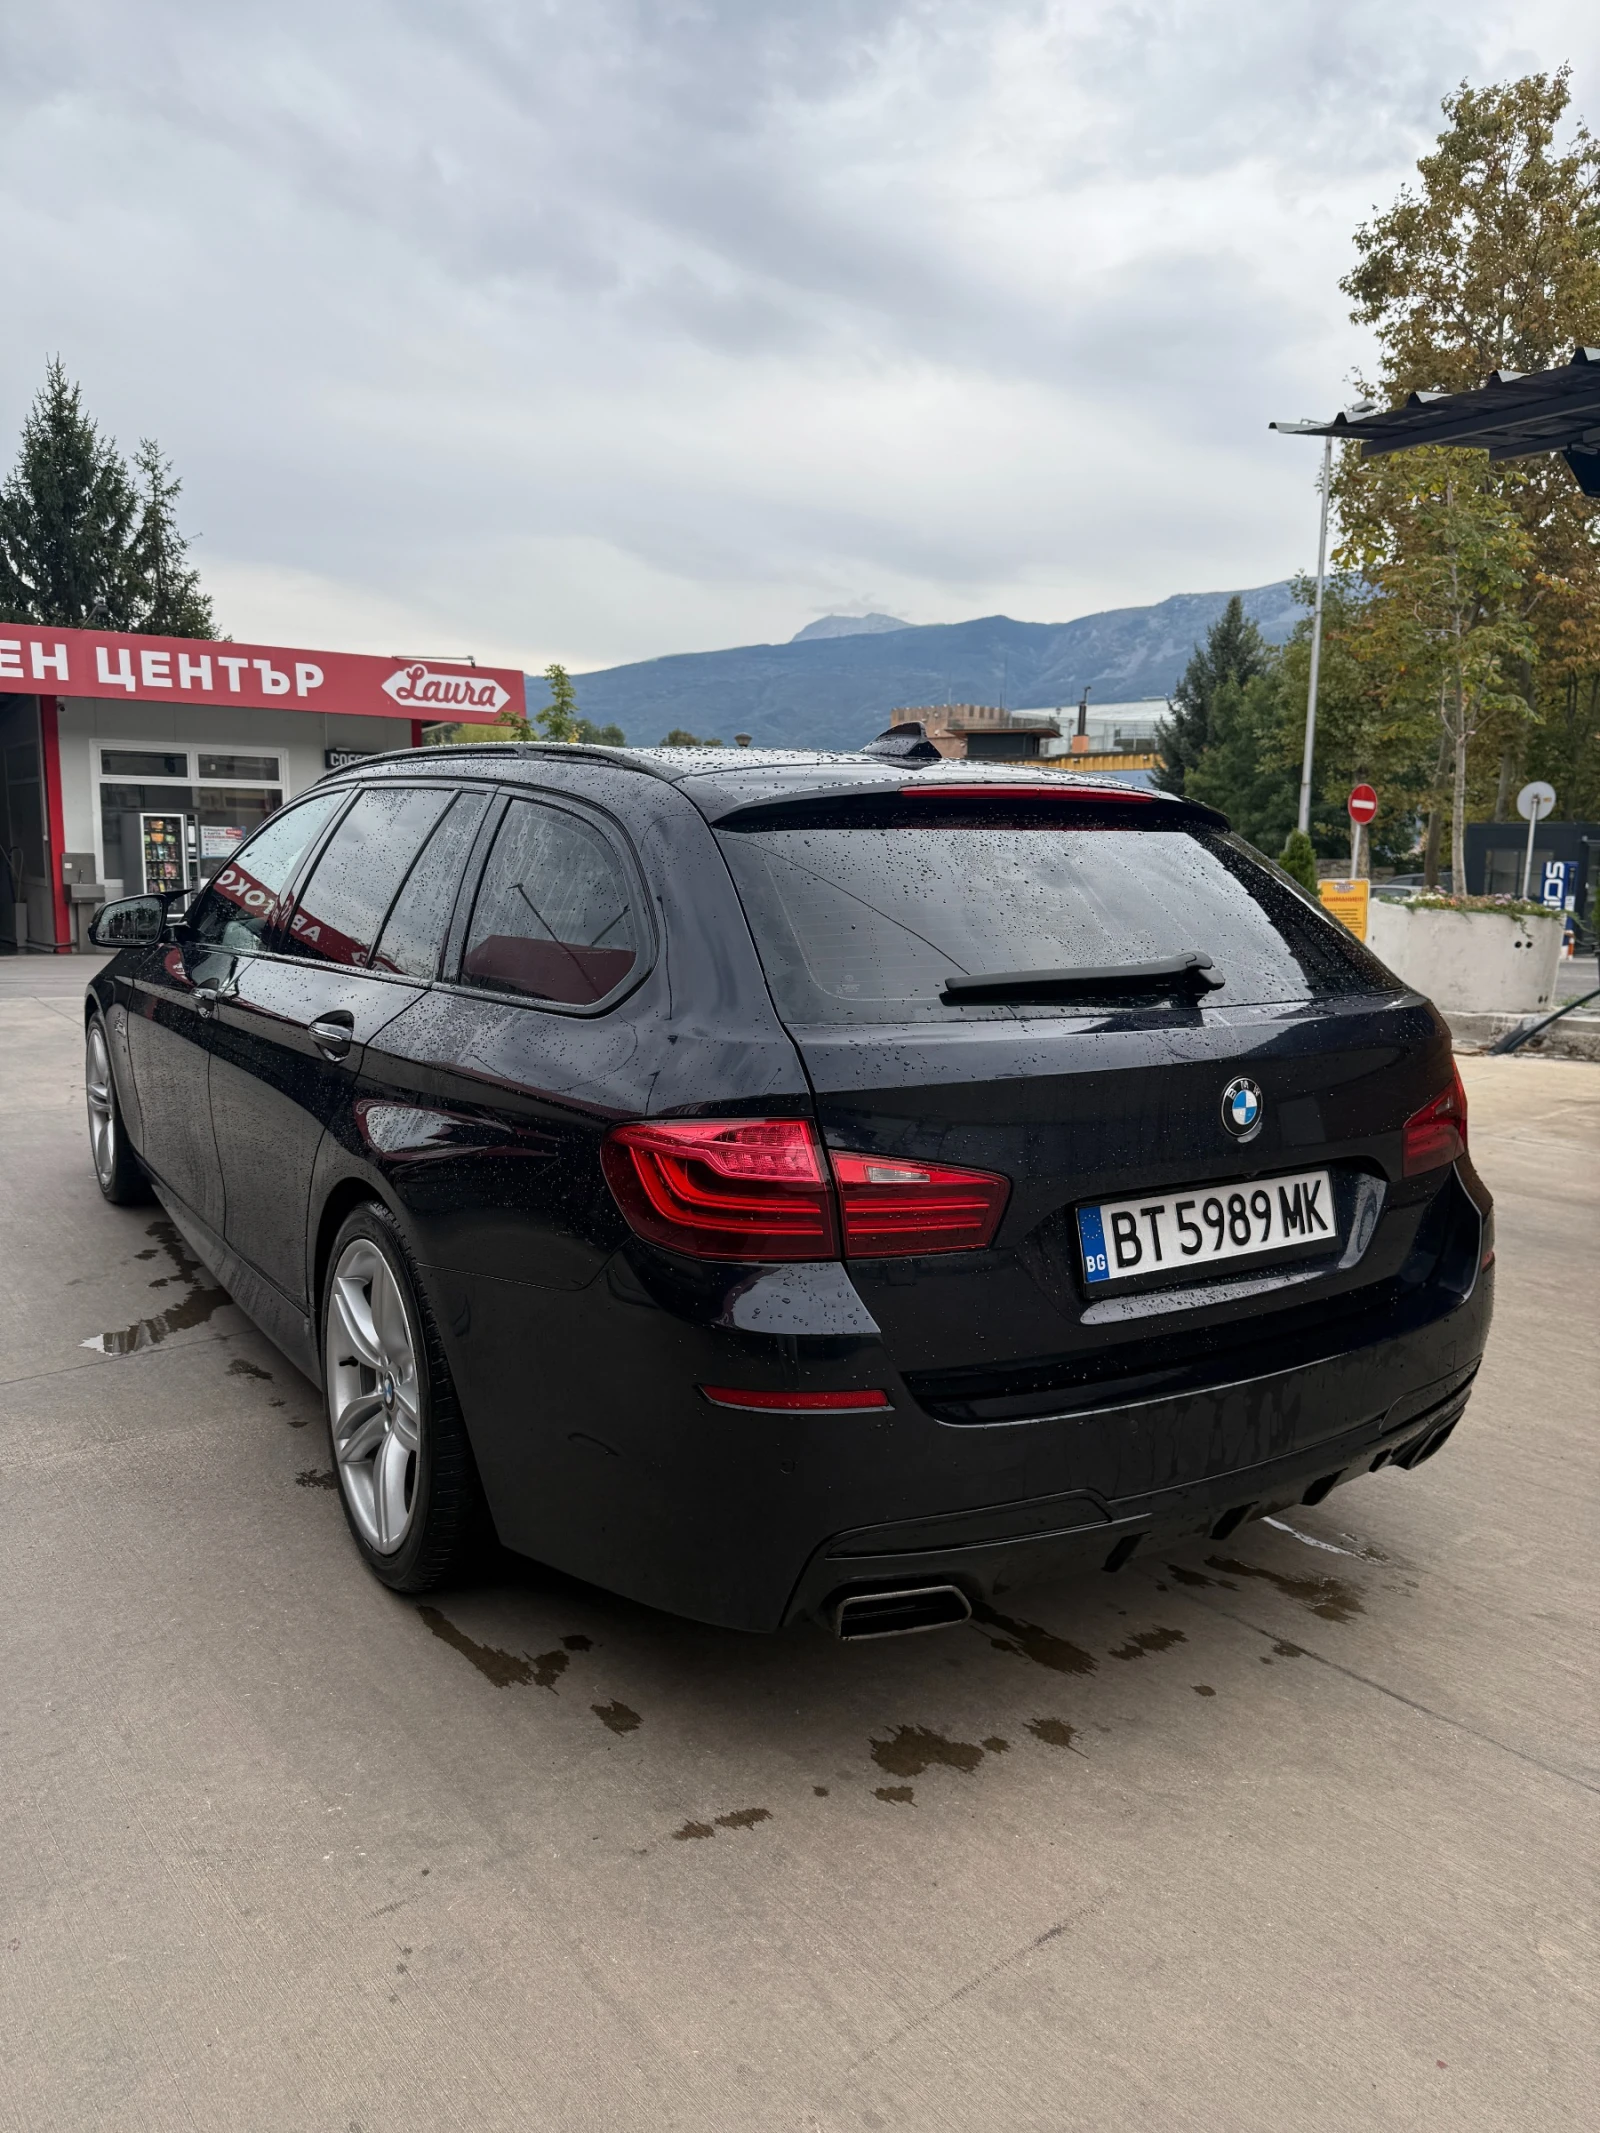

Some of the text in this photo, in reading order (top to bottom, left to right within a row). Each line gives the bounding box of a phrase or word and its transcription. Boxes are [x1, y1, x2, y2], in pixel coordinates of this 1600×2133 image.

[96, 646, 325, 697] ЦЕНТЪР
[396, 666, 497, 707] Laura
[1227, 1080, 1261, 1100] BMW
[1086, 1253, 1106, 1273] BG
